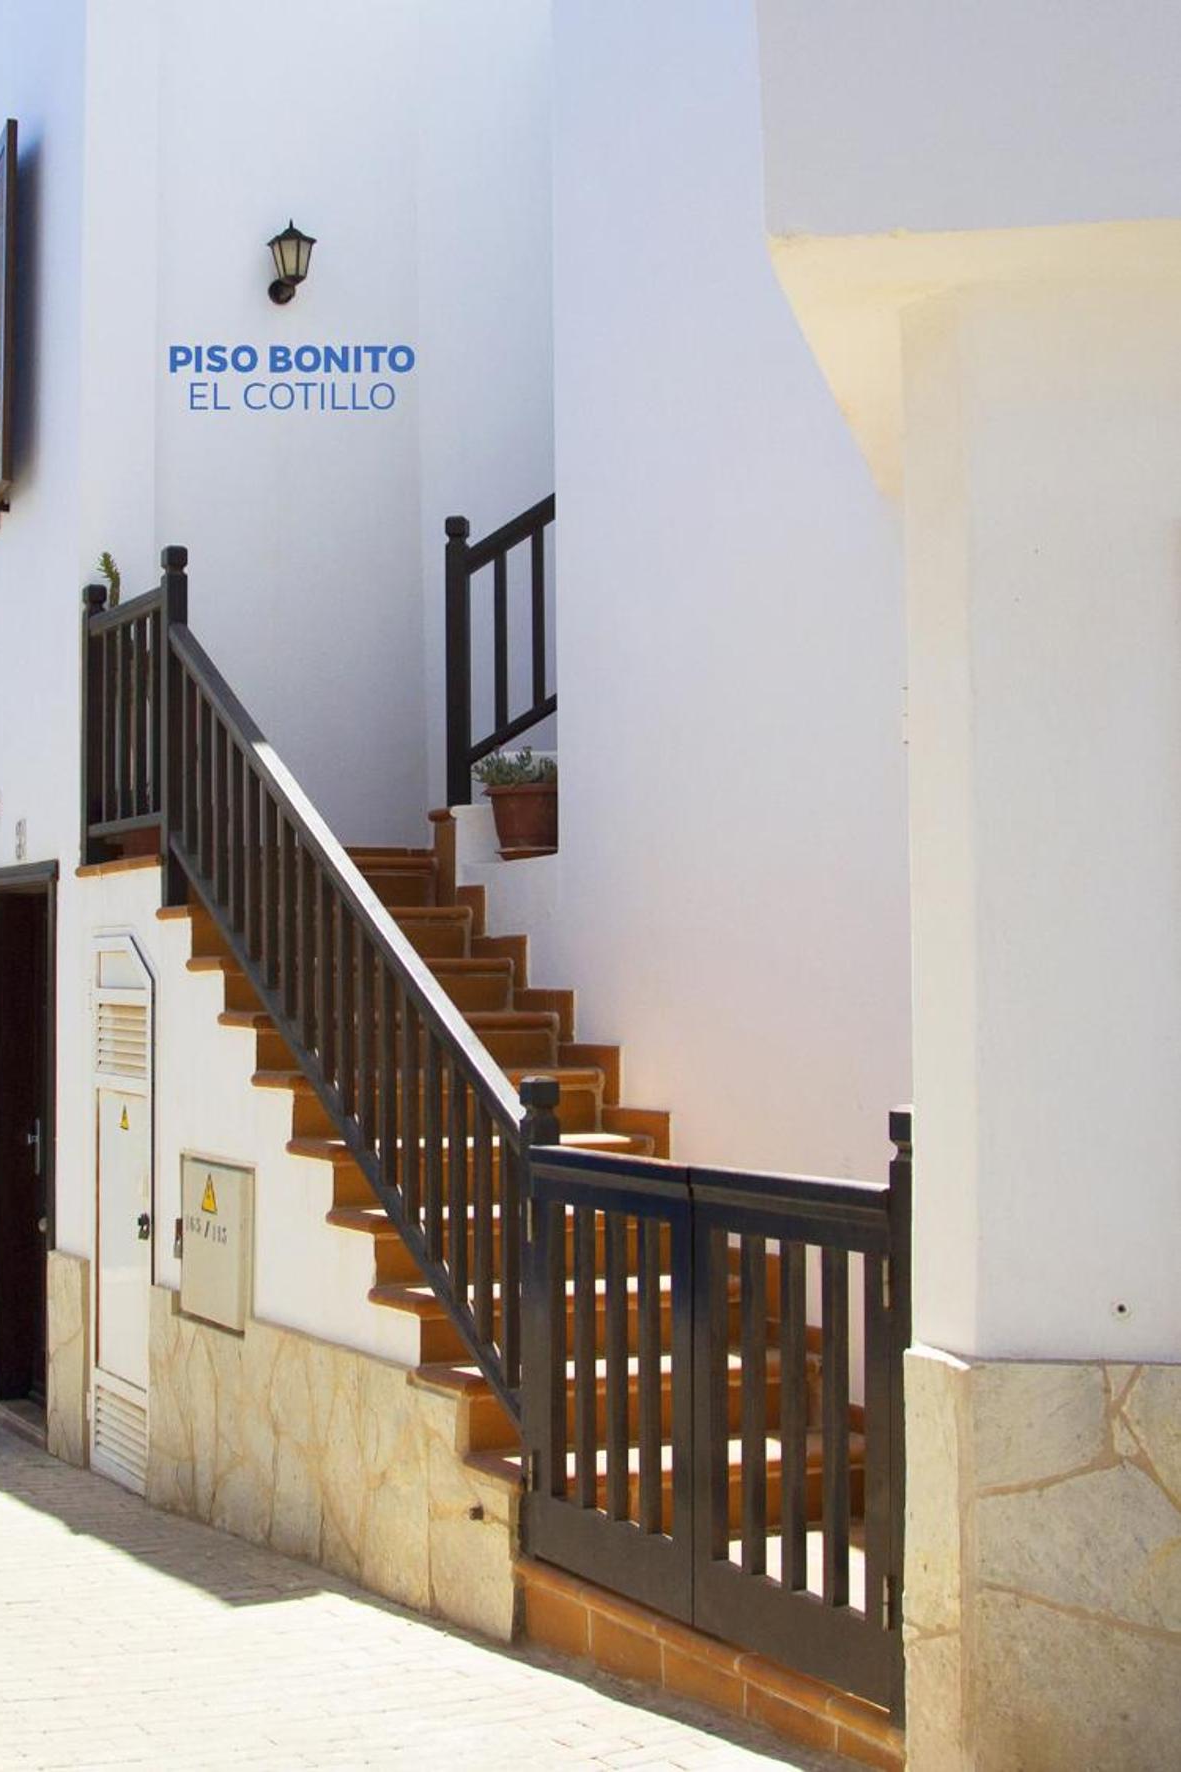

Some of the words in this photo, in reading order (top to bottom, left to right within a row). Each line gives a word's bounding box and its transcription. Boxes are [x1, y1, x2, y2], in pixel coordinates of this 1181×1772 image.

[169, 345, 259, 374] PISO
[269, 345, 416, 374] BONITO
[190, 382, 231, 411] EL
[243, 382, 396, 411] COTILLO
